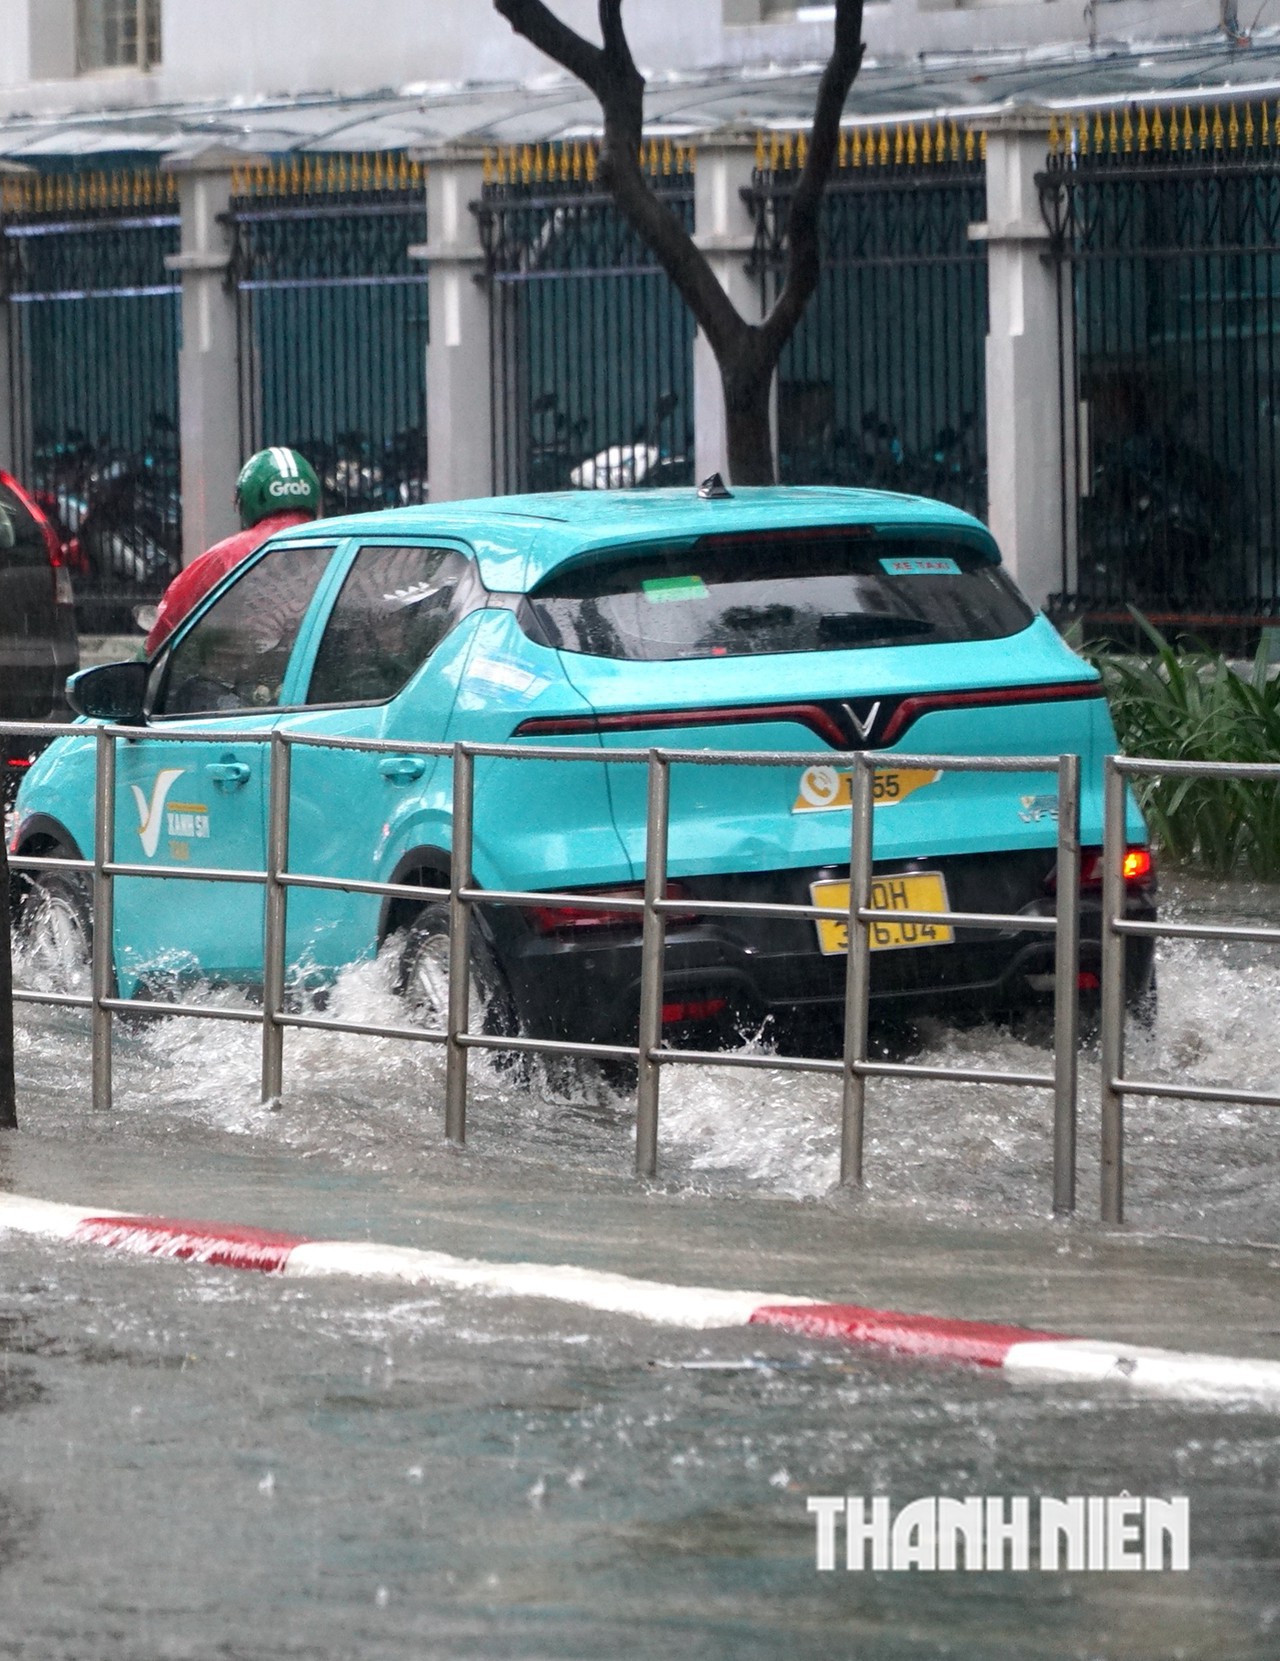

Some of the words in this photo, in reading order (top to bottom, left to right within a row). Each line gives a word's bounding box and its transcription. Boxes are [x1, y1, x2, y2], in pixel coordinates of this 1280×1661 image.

[269, 479, 311, 497] Grab
[846, 774, 900, 801] 155
[833, 920, 937, 948] 36.04
